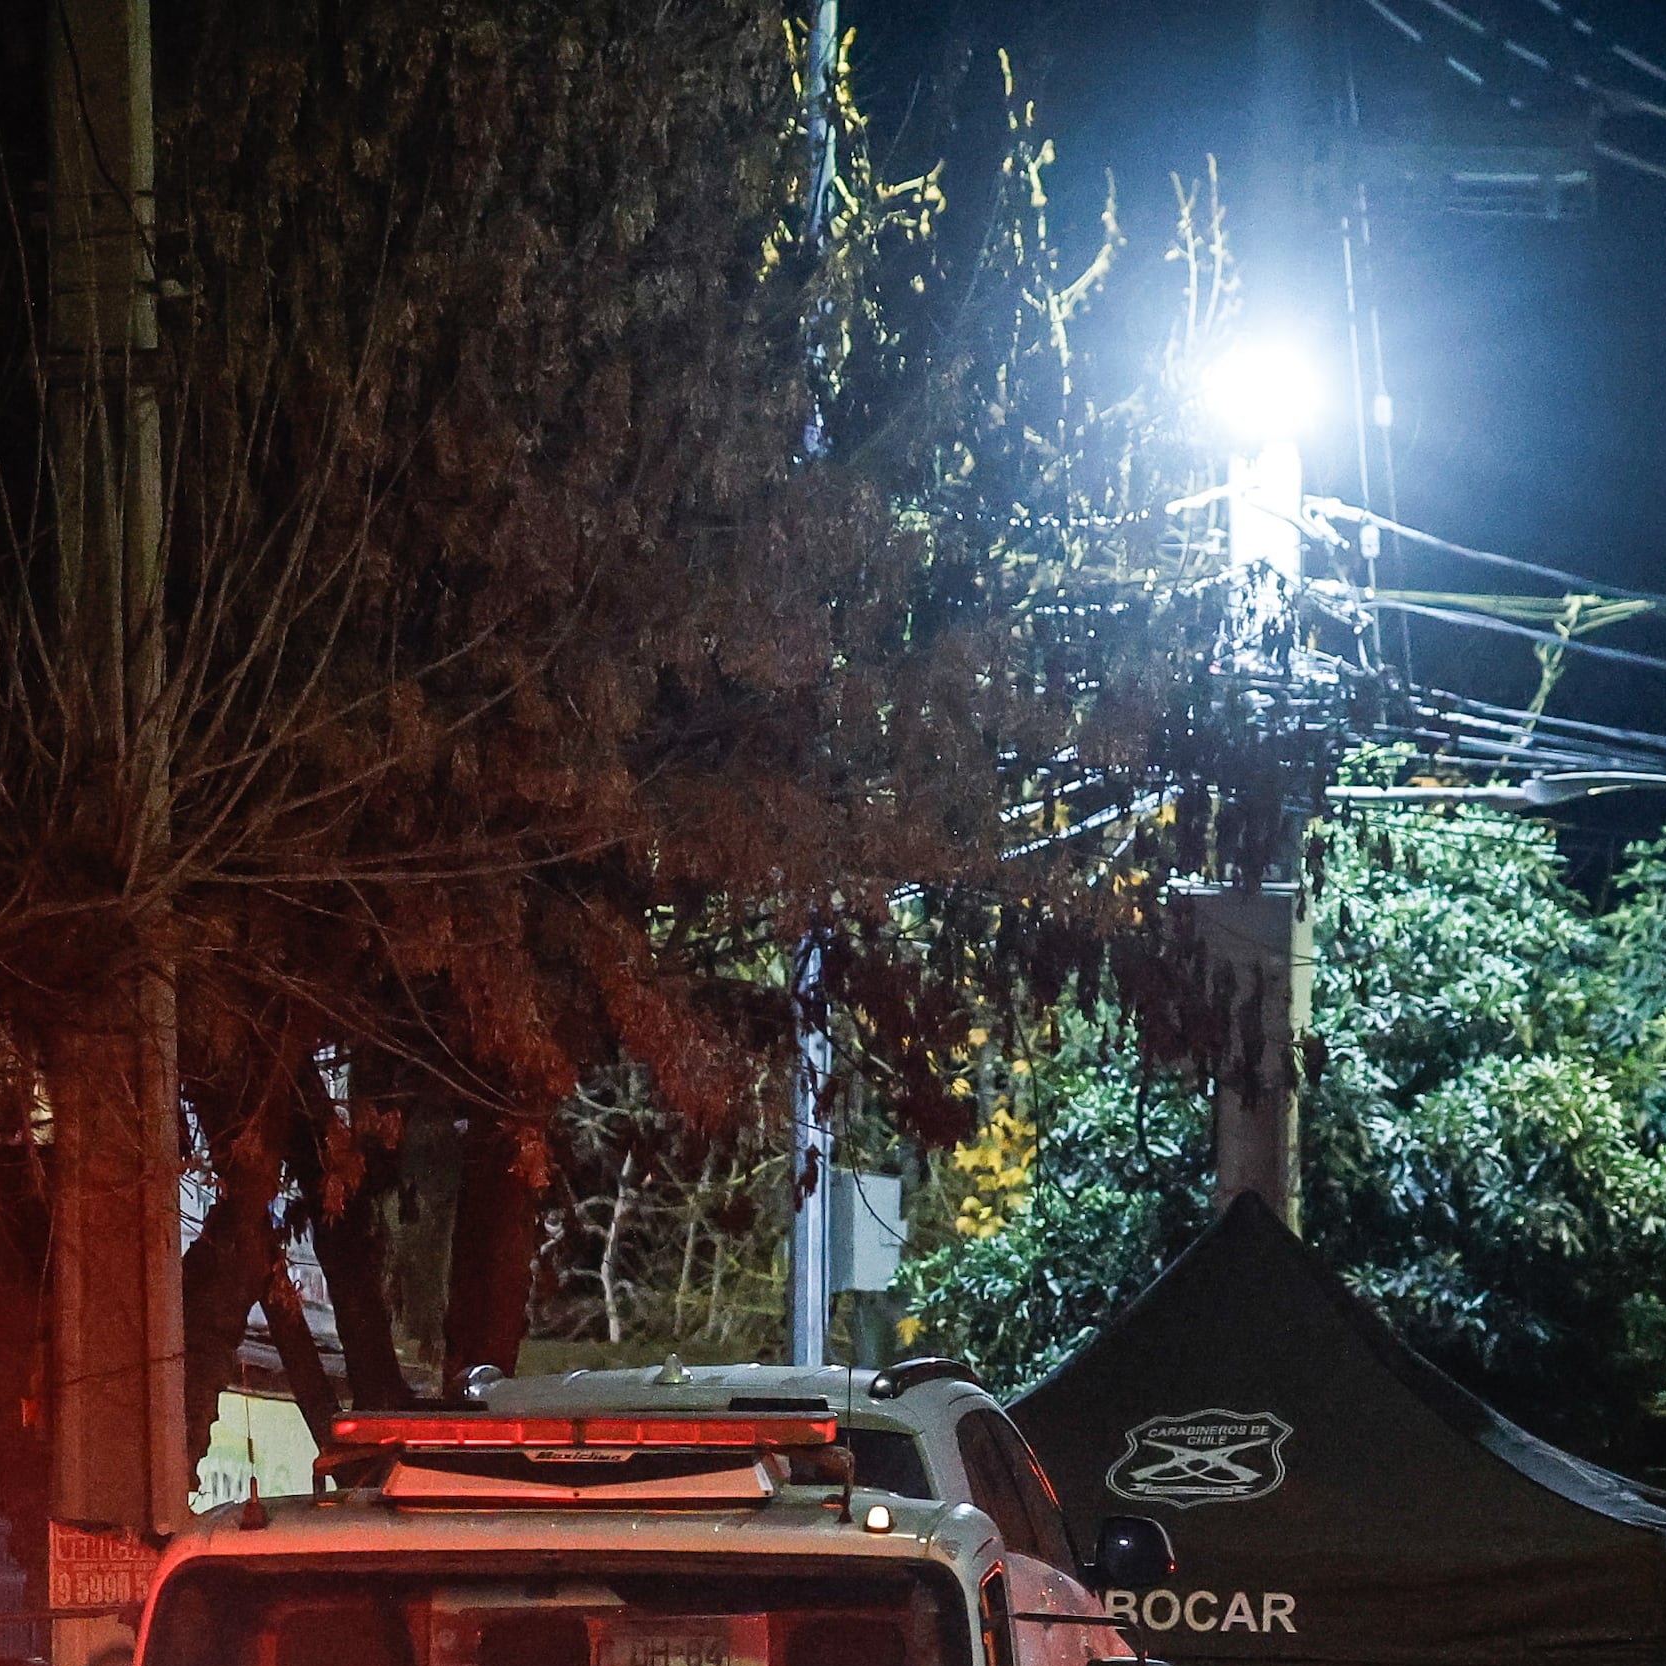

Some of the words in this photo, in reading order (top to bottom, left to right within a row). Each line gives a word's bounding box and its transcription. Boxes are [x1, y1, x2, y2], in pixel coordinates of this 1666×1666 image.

[1147, 1425, 1247, 1438] CARABINEROS
[1250, 1425, 1270, 1436] DE
[1187, 1435, 1228, 1446] CHILE
